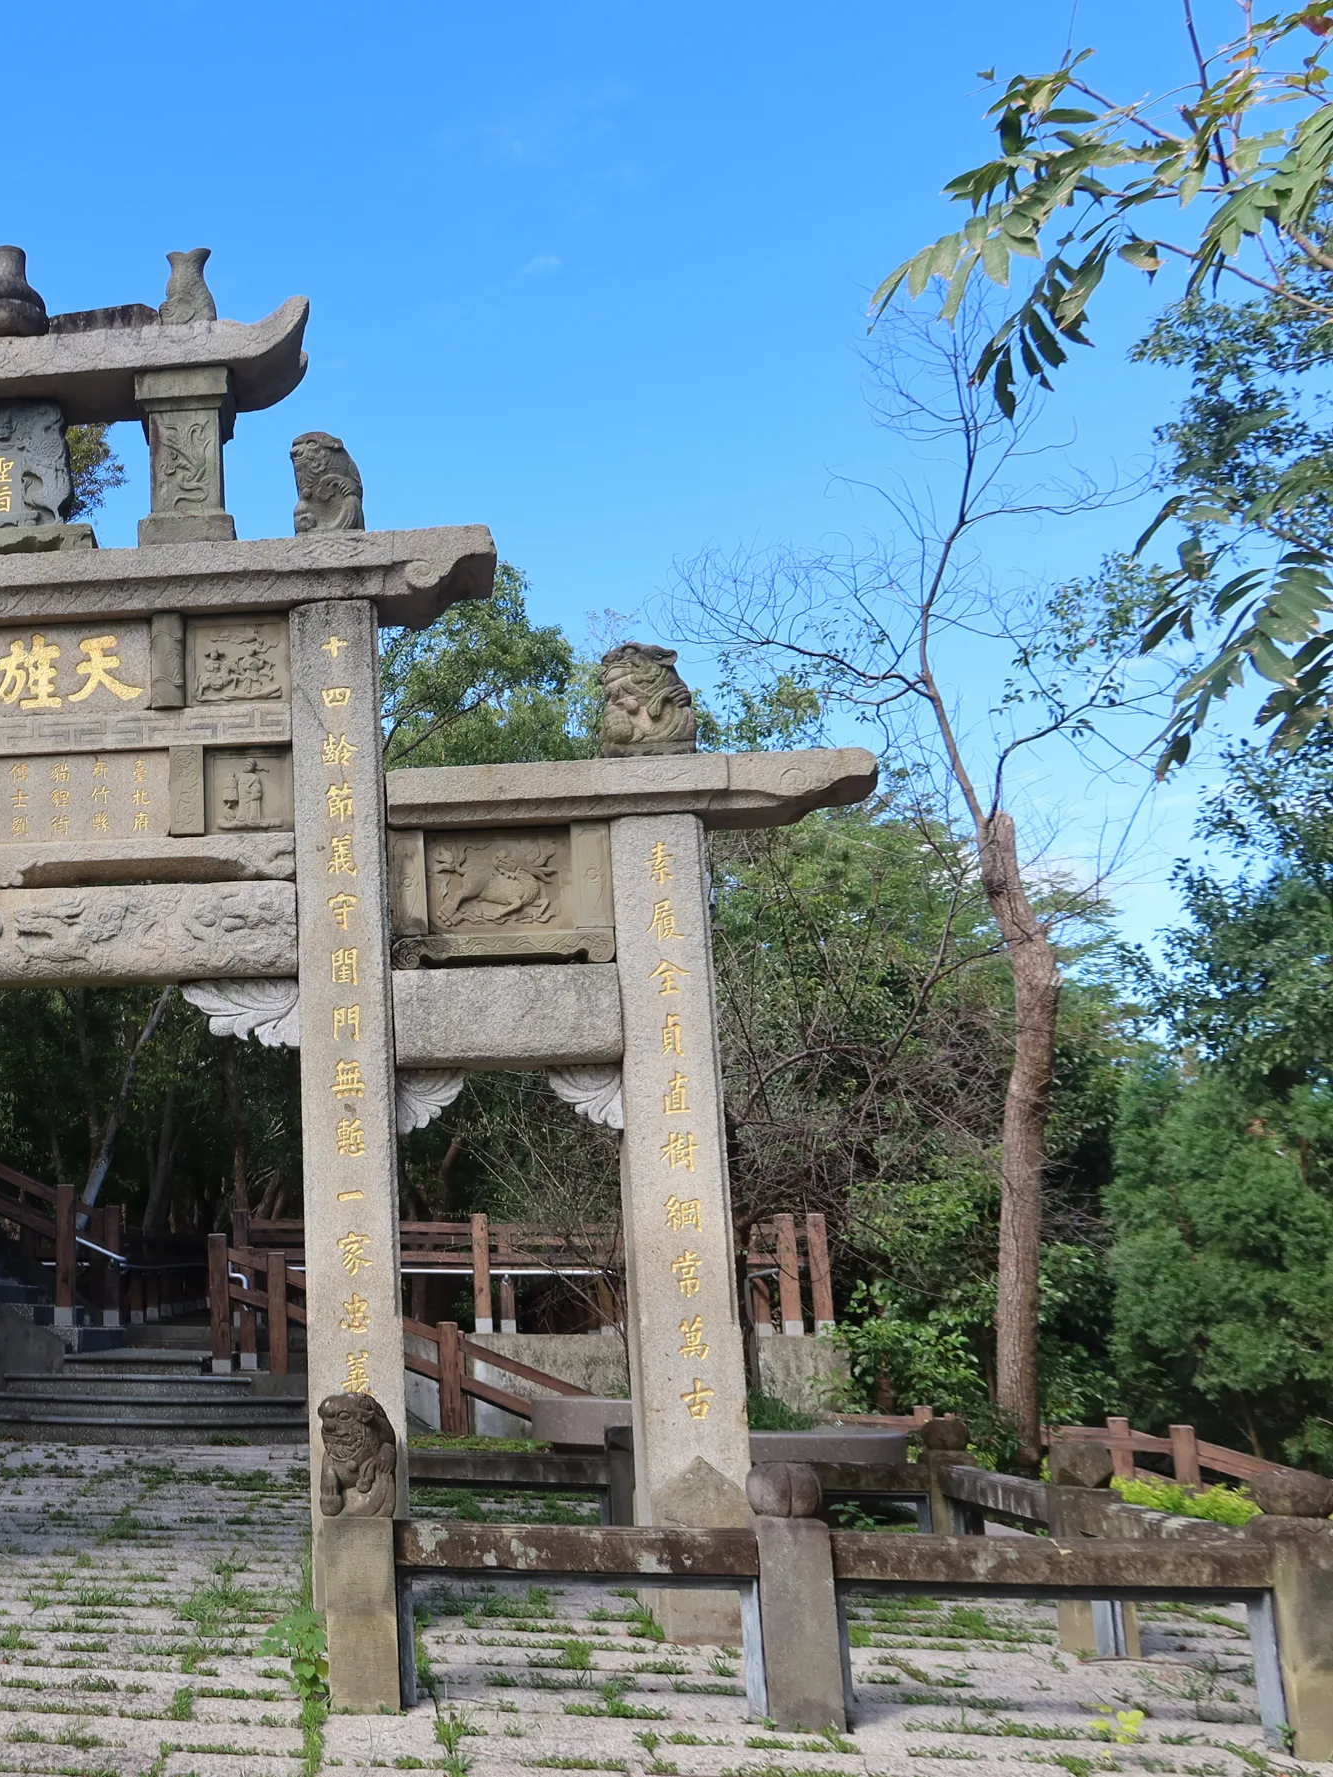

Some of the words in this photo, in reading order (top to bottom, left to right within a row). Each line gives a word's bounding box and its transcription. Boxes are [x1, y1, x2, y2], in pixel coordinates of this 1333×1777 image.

[9, 763, 29, 837] 儒士劉
[91, 760, 111, 832] 新竹縣
[132, 759, 151, 832] 臺北府
